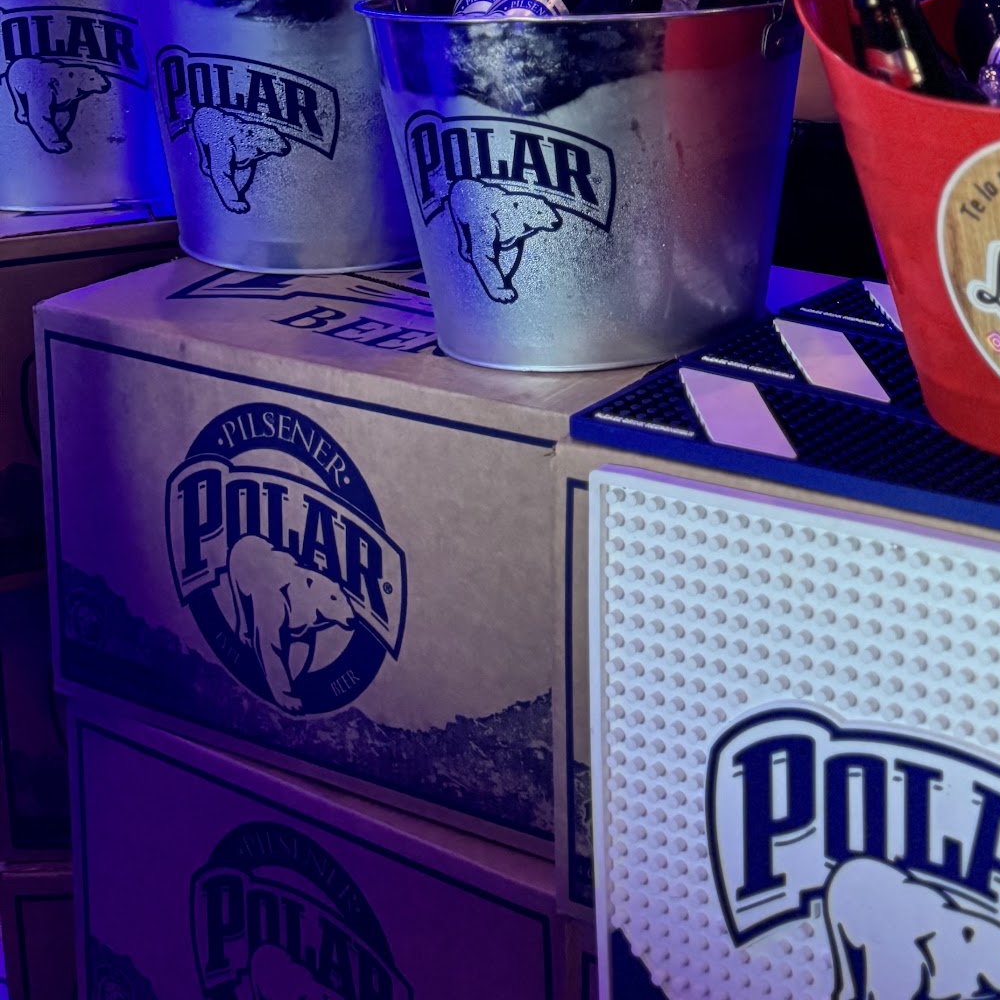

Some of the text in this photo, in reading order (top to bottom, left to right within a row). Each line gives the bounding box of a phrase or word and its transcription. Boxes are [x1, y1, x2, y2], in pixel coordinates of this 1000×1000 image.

[510, 0, 550, 17] PILSEN
[2, 14, 138, 71] OLAR
[160, 55, 324, 138] POLAR
[411, 122, 599, 207] POLAR
[960, 197, 986, 222] Te
[974, 178, 999, 202] lo
[222, 411, 347, 487] PILSENER
[177, 468, 389, 626] POLAR
[331, 669, 361, 698] BEER
